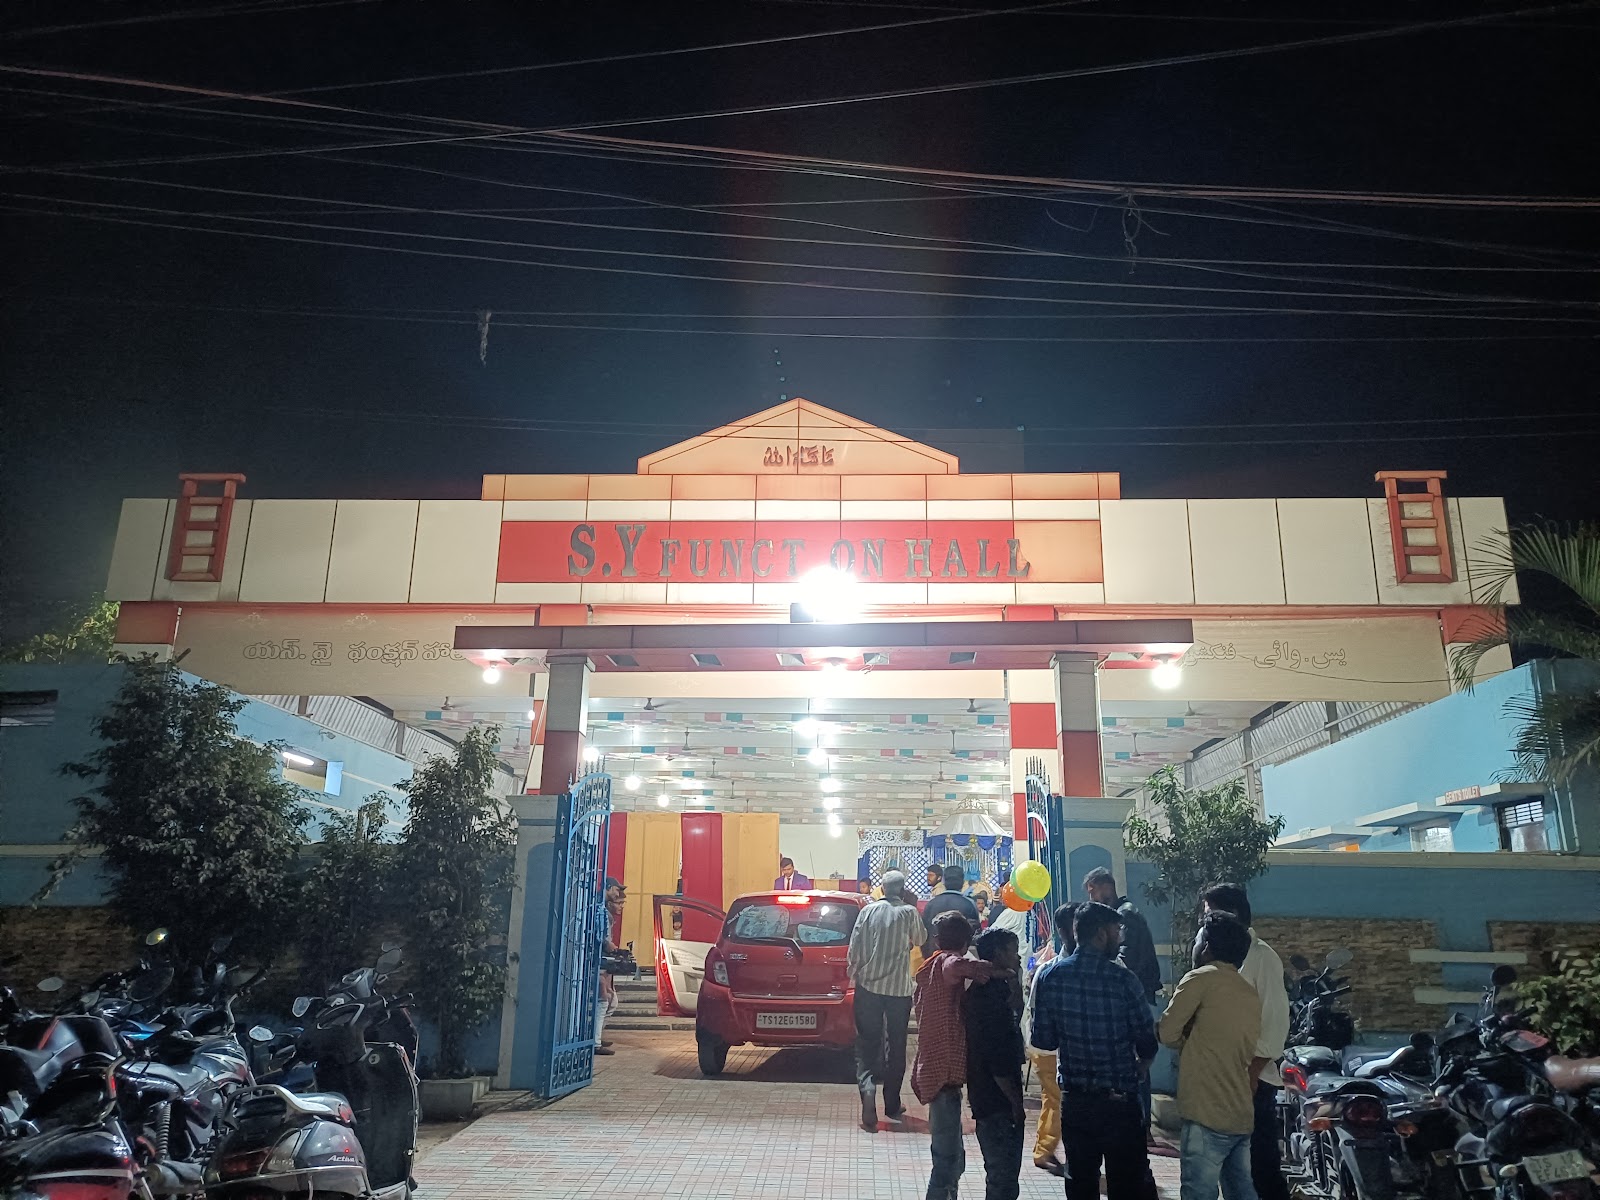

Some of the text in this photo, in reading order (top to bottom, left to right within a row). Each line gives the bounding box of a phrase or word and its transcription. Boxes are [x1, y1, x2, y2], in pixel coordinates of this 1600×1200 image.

[658, 539, 886, 577] FUNCTON
[905, 538, 1031, 578] HALL
[310, 641, 332, 666] వై
[762, 1015, 816, 1026] TS12EG1580
[327, 1154, 355, 1163] Activa
